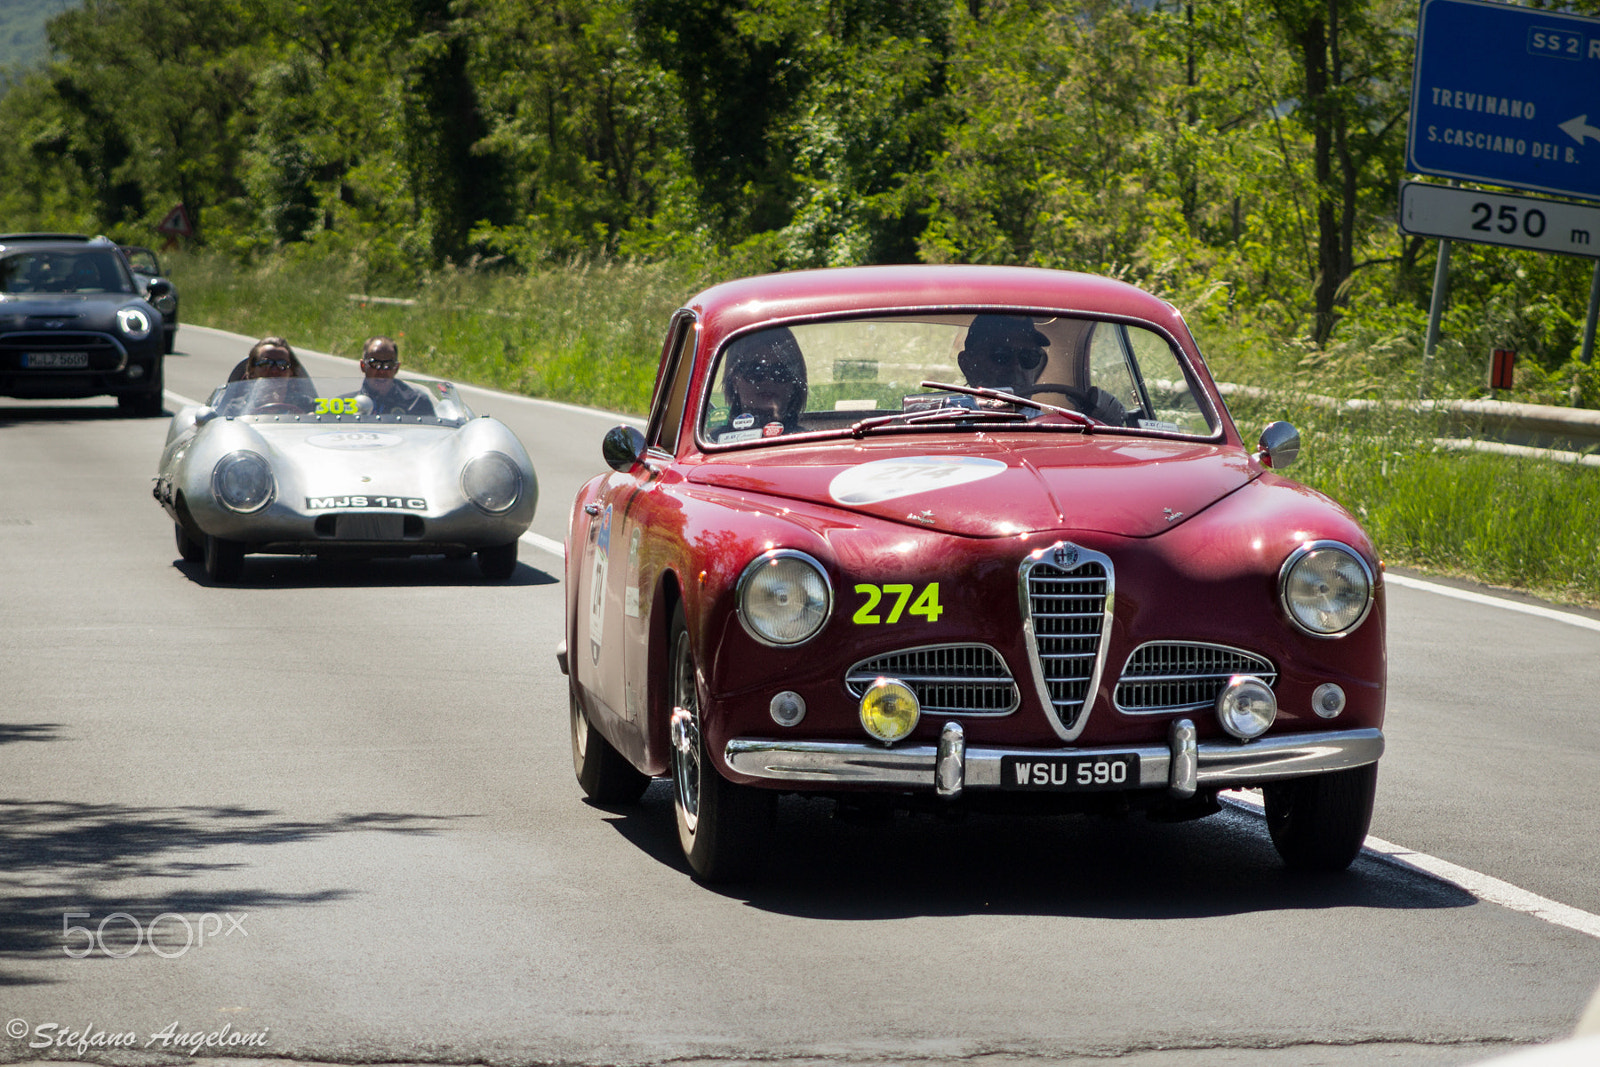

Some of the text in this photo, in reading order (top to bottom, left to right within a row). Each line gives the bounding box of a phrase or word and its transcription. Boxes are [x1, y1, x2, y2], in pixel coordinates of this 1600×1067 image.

[1533, 33, 1560, 50] SS
[1566, 38, 1578, 53] 2
[1432, 87, 1536, 120] TREVINANO
[1532, 141, 1558, 161] DEI
[1565, 146, 1580, 164] B.
[1471, 202, 1590, 245] 250 m
[314, 398, 359, 415] 303
[329, 433, 380, 442] 303
[865, 466, 962, 482] 274
[309, 496, 425, 509] MJS 11C
[852, 582, 944, 625] 274
[1015, 761, 1127, 785] WSU 590
